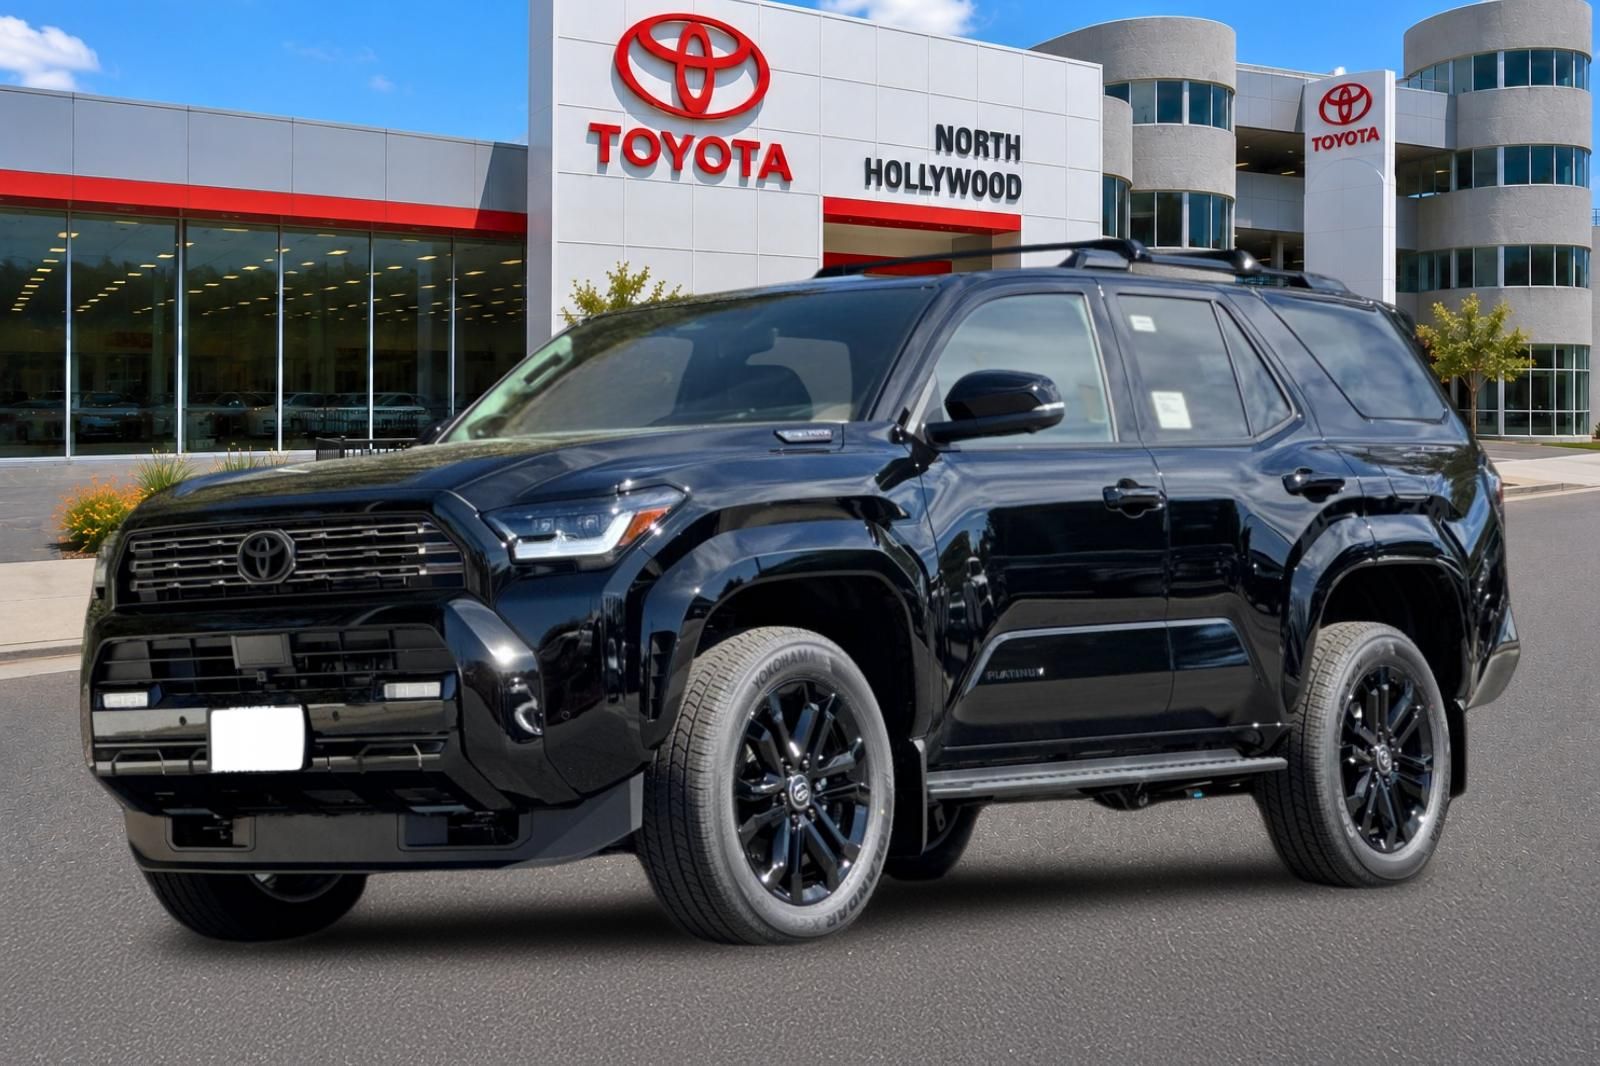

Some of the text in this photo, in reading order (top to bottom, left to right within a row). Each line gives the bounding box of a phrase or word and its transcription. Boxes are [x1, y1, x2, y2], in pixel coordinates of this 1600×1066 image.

[588, 122, 793, 182] TOYOTA
[935, 123, 1021, 161] NORTH
[1311, 126, 1380, 152] TOYOTA
[865, 157, 1022, 200] HOLLYWOOD
[752, 649, 817, 690] YOKOHAMA
[987, 666, 1045, 680] PLATINUM
